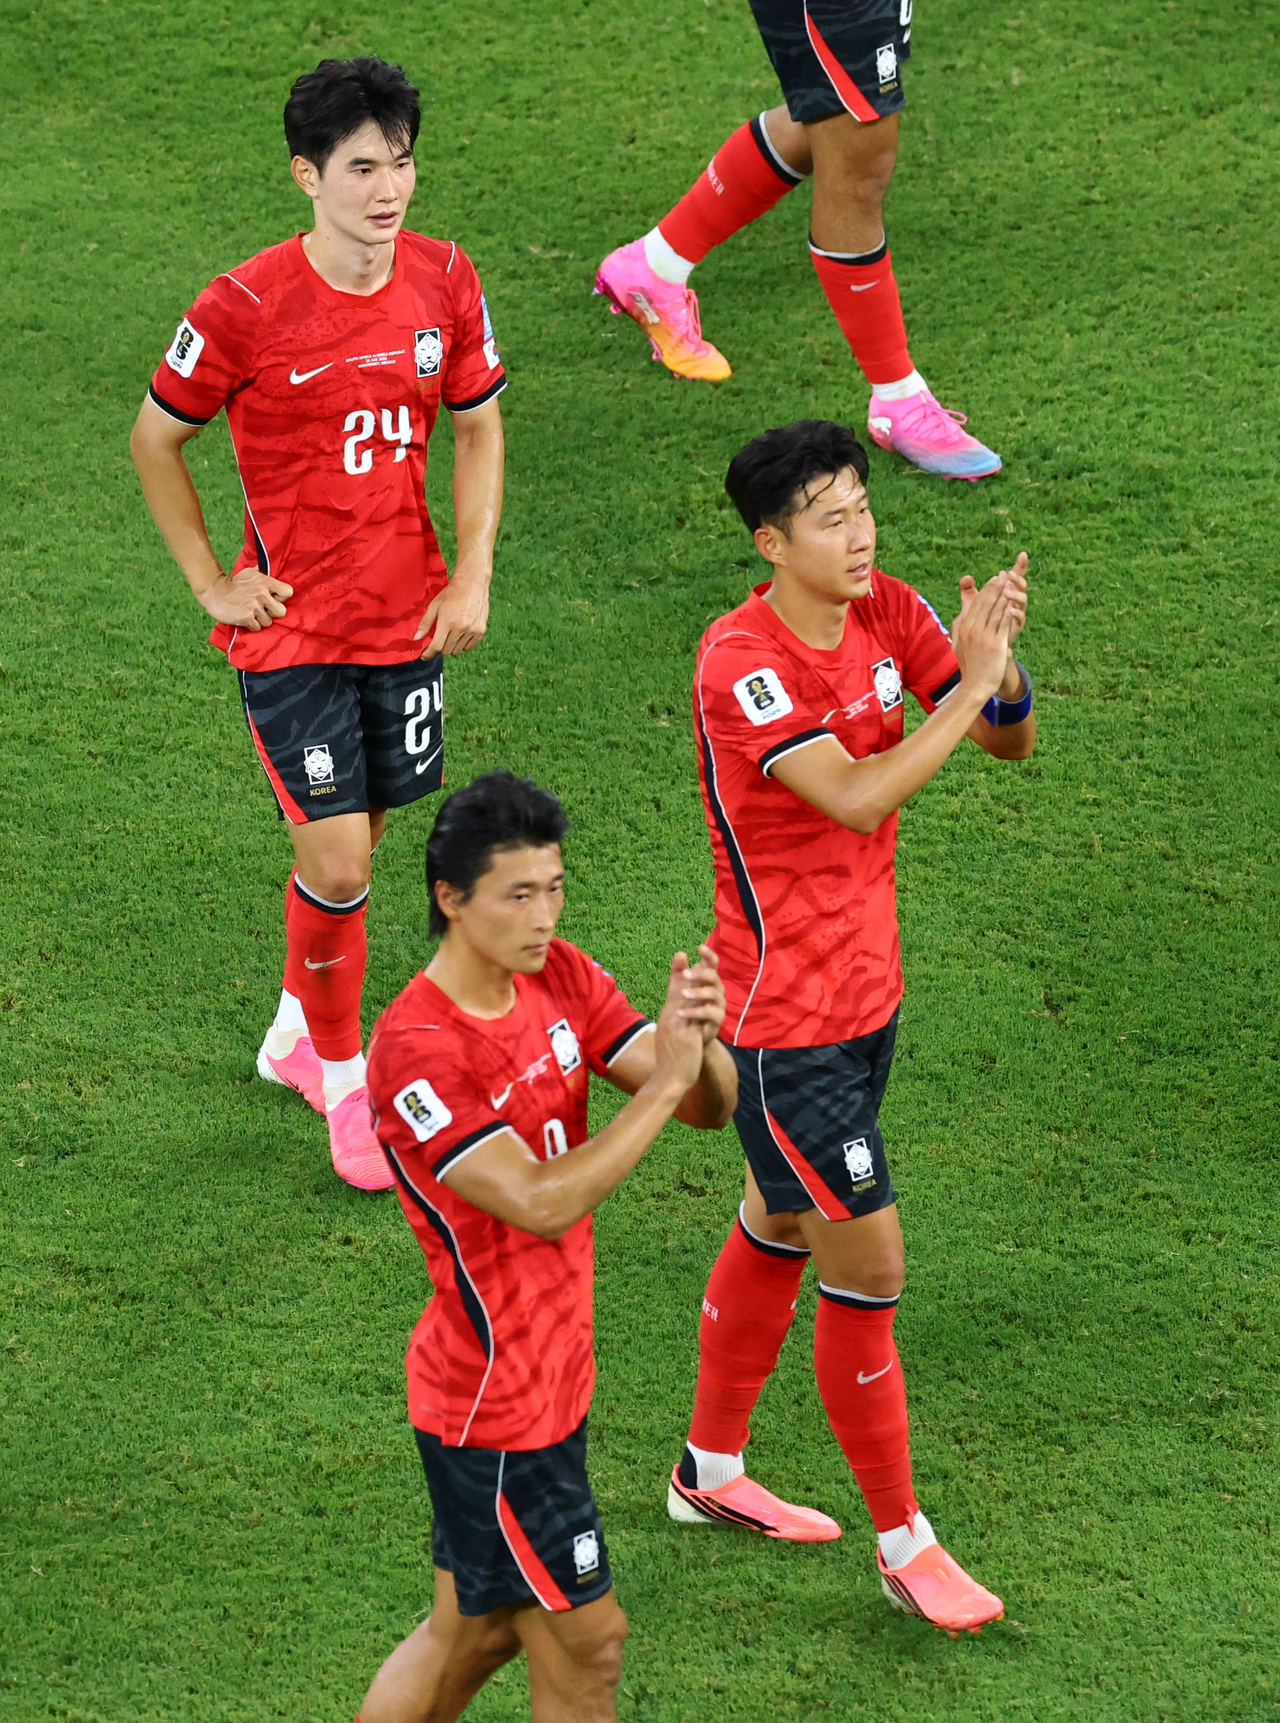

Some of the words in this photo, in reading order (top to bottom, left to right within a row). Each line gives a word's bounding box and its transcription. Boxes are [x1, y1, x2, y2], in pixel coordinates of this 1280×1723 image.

[342, 405, 413, 475] 24
[309, 785, 337, 797] KOREA
[852, 1178, 877, 1192] KOREA
